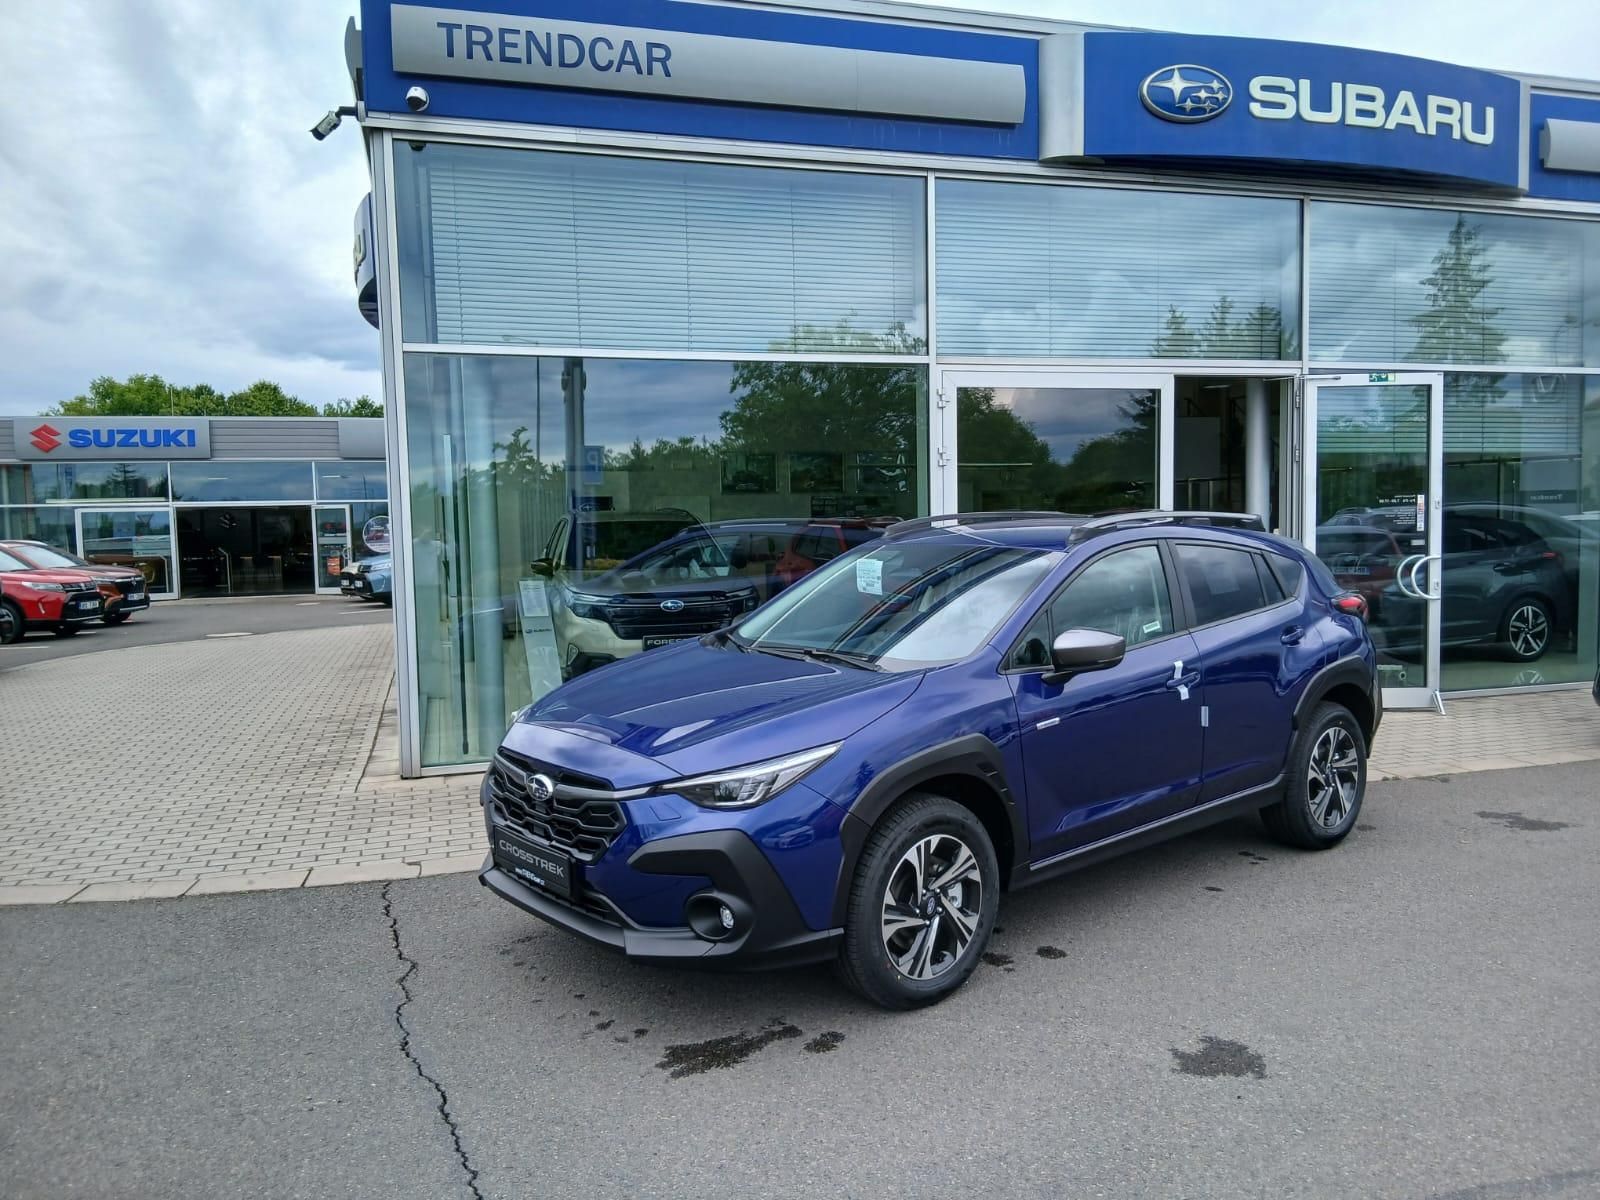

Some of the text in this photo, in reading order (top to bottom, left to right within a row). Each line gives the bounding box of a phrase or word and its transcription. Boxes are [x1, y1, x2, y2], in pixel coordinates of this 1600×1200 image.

[436, 22, 672, 77] TRENDCAR
[1248, 75, 1495, 145] SUBARU
[68, 428, 196, 448] SUZUKI
[499, 839, 564, 878] CROSSTREK
